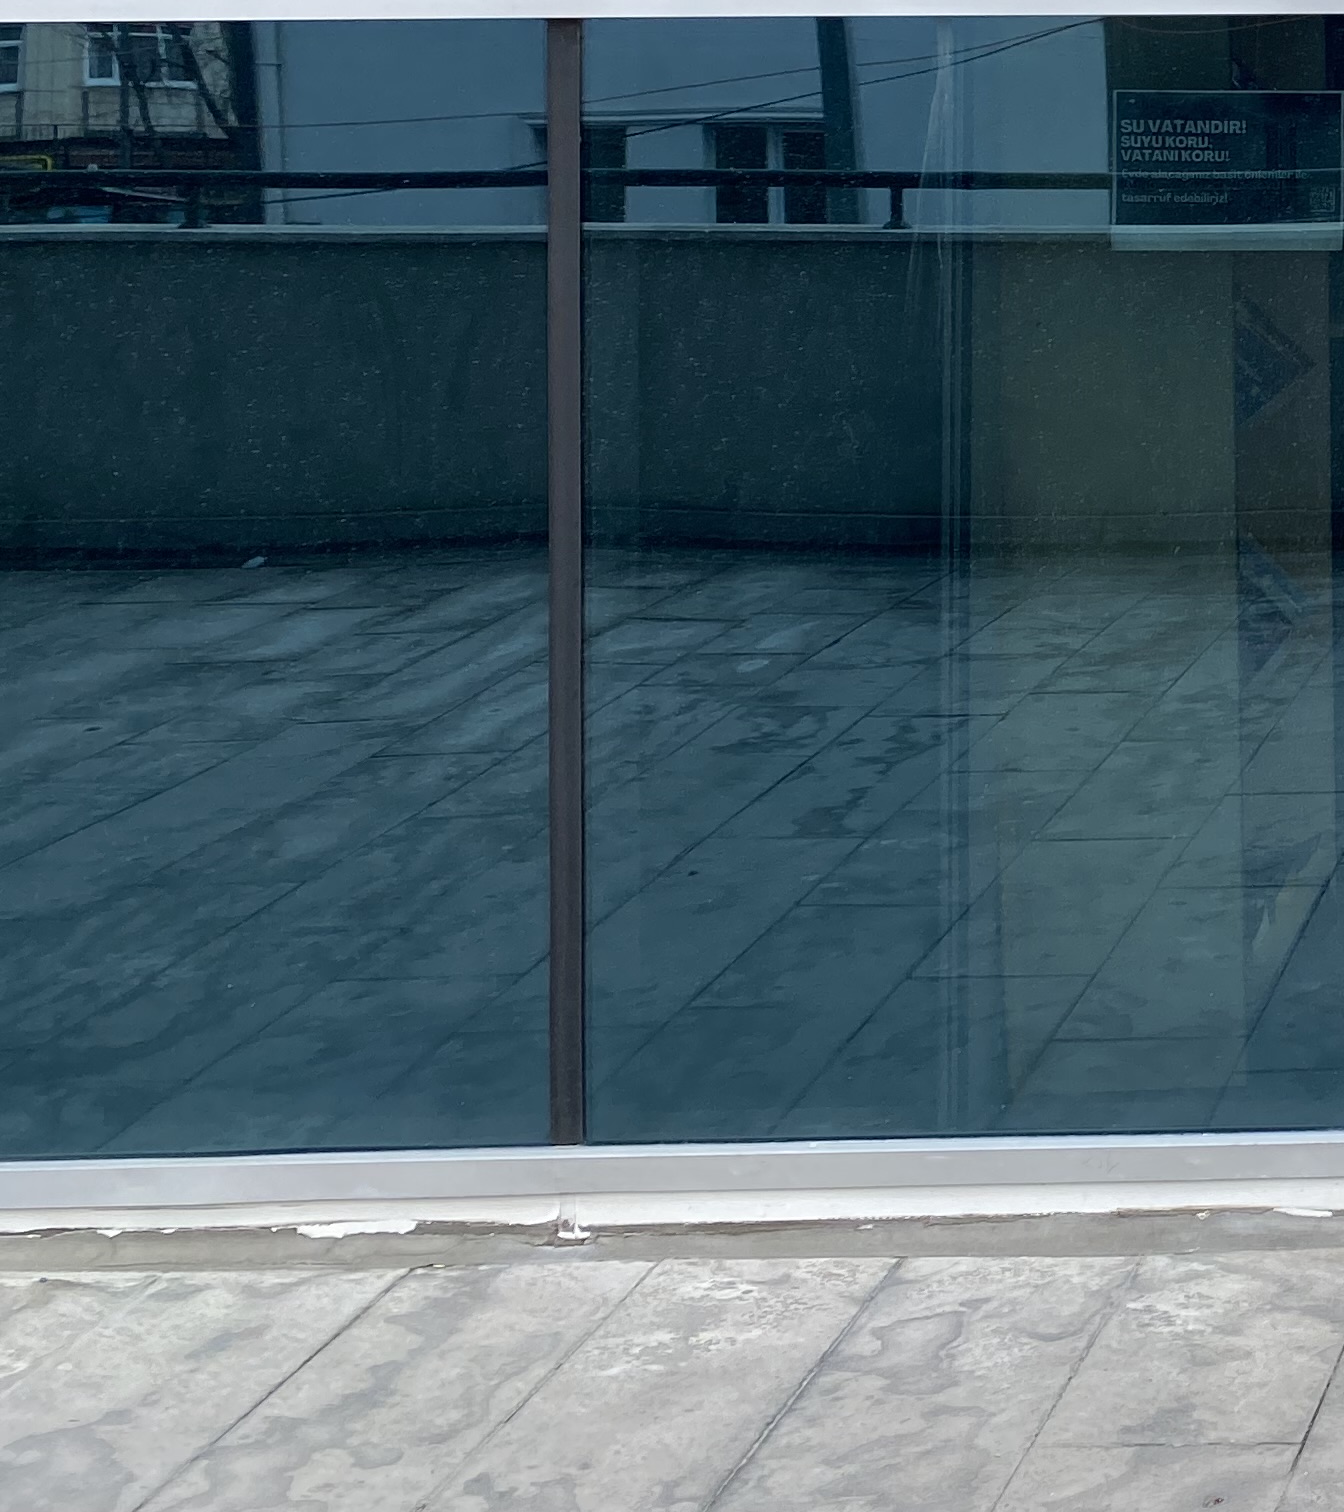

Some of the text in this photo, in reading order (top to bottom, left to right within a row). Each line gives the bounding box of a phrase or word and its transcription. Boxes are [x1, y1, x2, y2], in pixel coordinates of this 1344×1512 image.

[1120, 120, 1143, 133] SU
[1120, 136, 1163, 147] SUYU
[1120, 150, 1230, 162] VATANI KORU!
